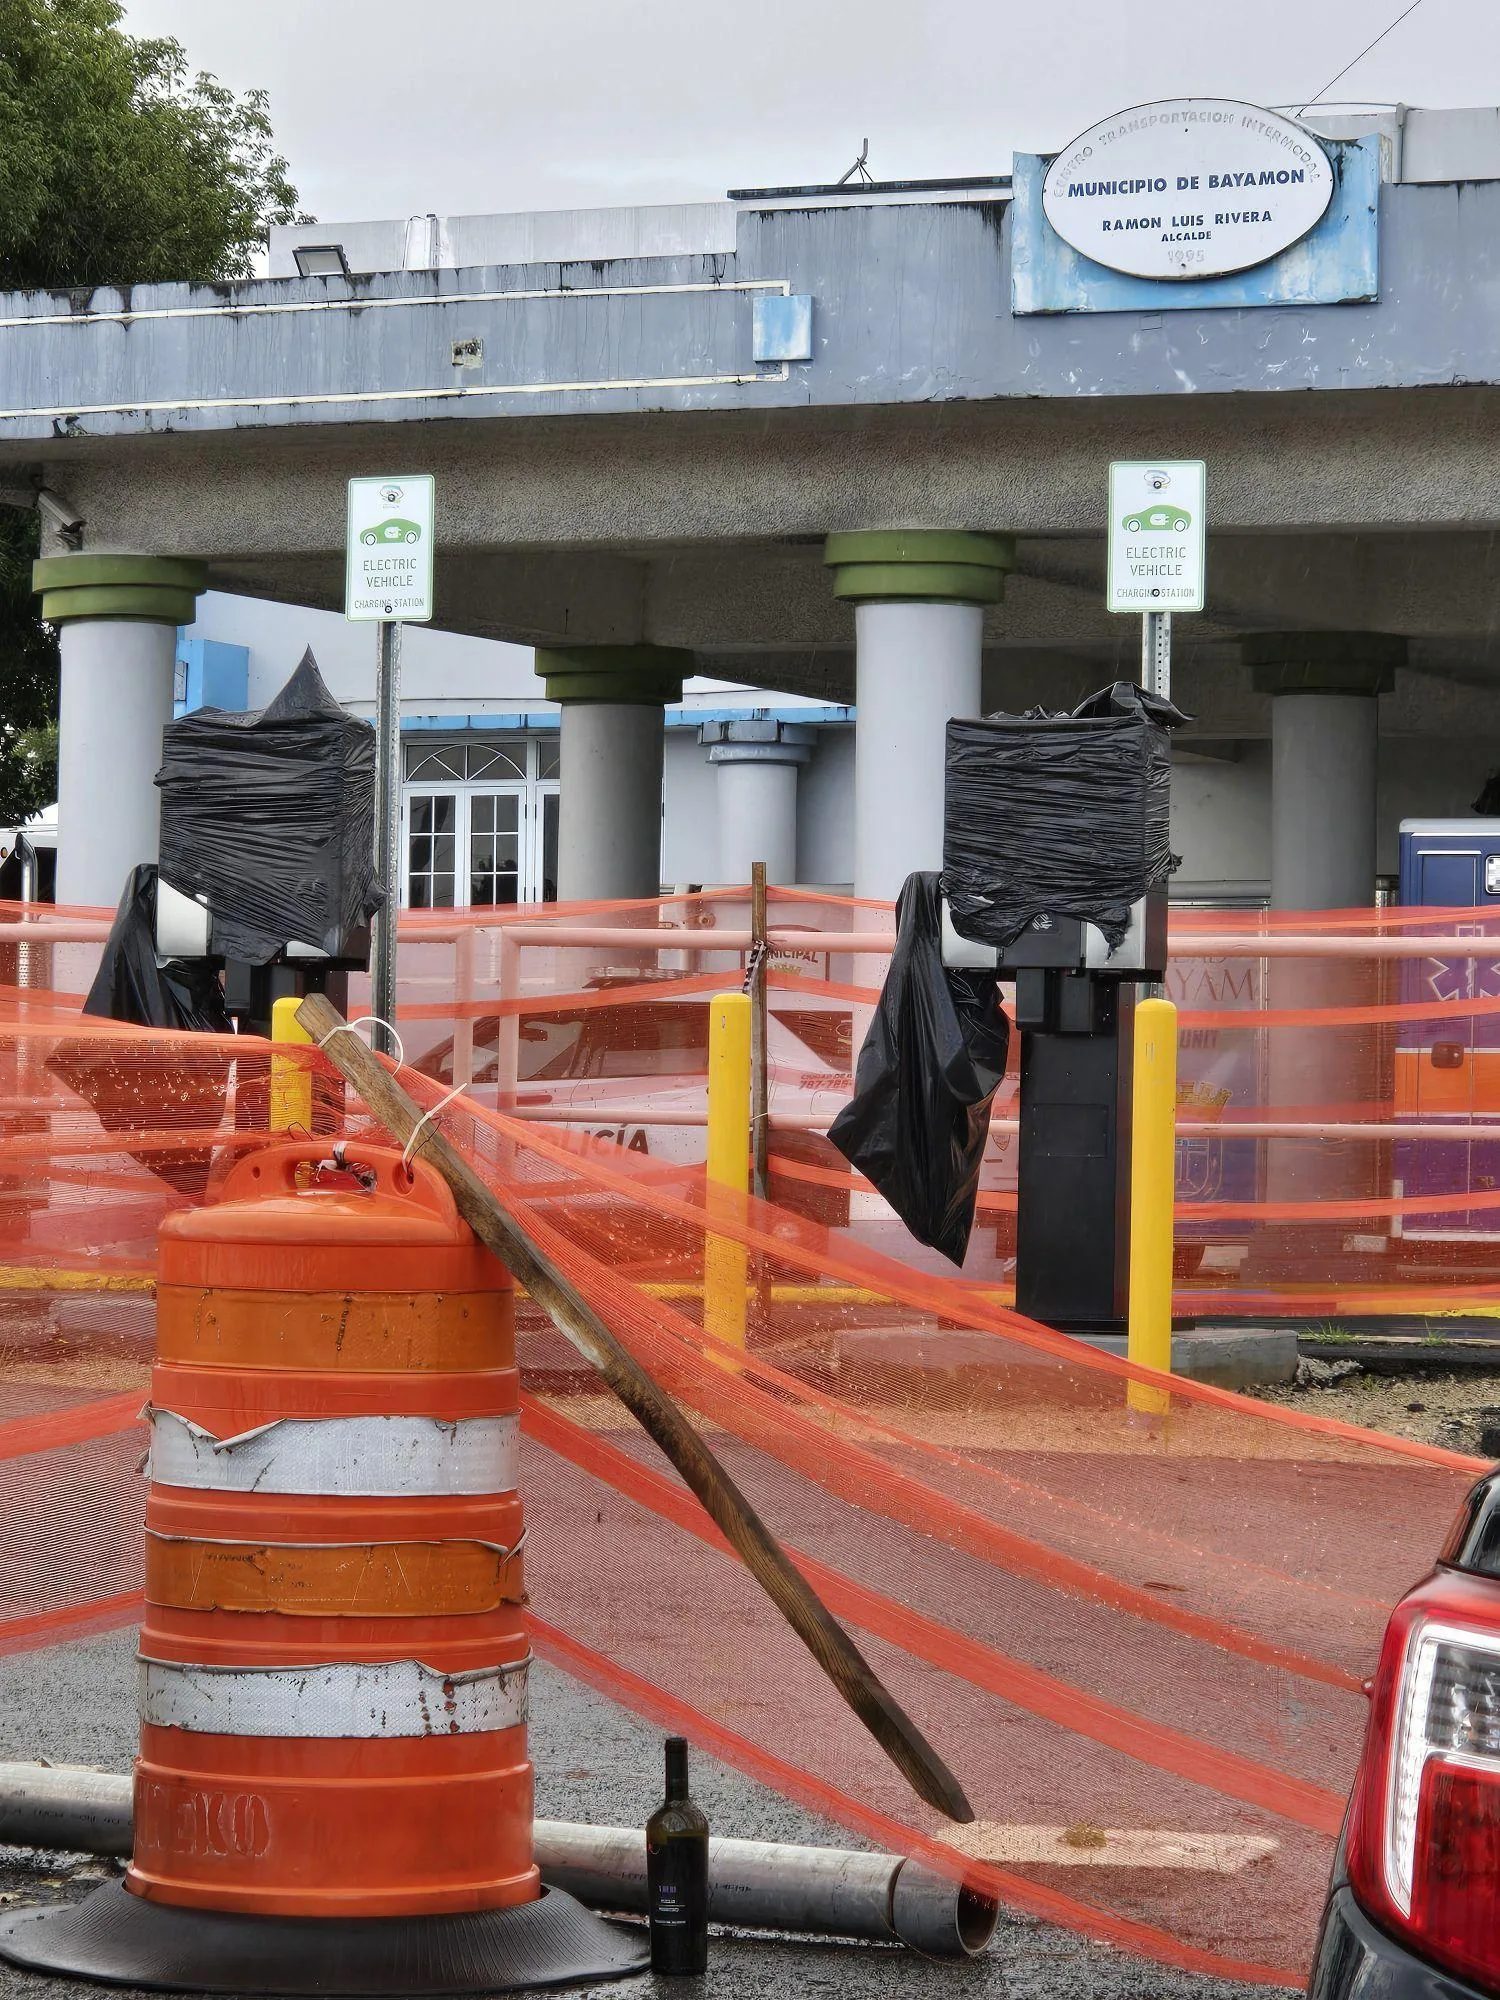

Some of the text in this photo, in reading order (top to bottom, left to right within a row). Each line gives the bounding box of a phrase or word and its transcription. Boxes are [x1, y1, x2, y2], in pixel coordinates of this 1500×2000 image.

[1068, 168, 1305, 198] MUNICIPIO DE BAYAMON
[1102, 210, 1273, 232] RAMON LUIS RIVERA
[1160, 230, 1212, 242] ALCALDE
[1167, 250, 1205, 263] 1995
[1126, 547, 1186, 558] ELECTRIC
[363, 558, 416, 571] ELECTRIC
[1130, 565, 1182, 576] VEHICLE
[366, 575, 413, 587] VEHICLE
[1117, 588, 1194, 598] CHARGIN STATION
[354, 597, 424, 608] CHARGING STATION
